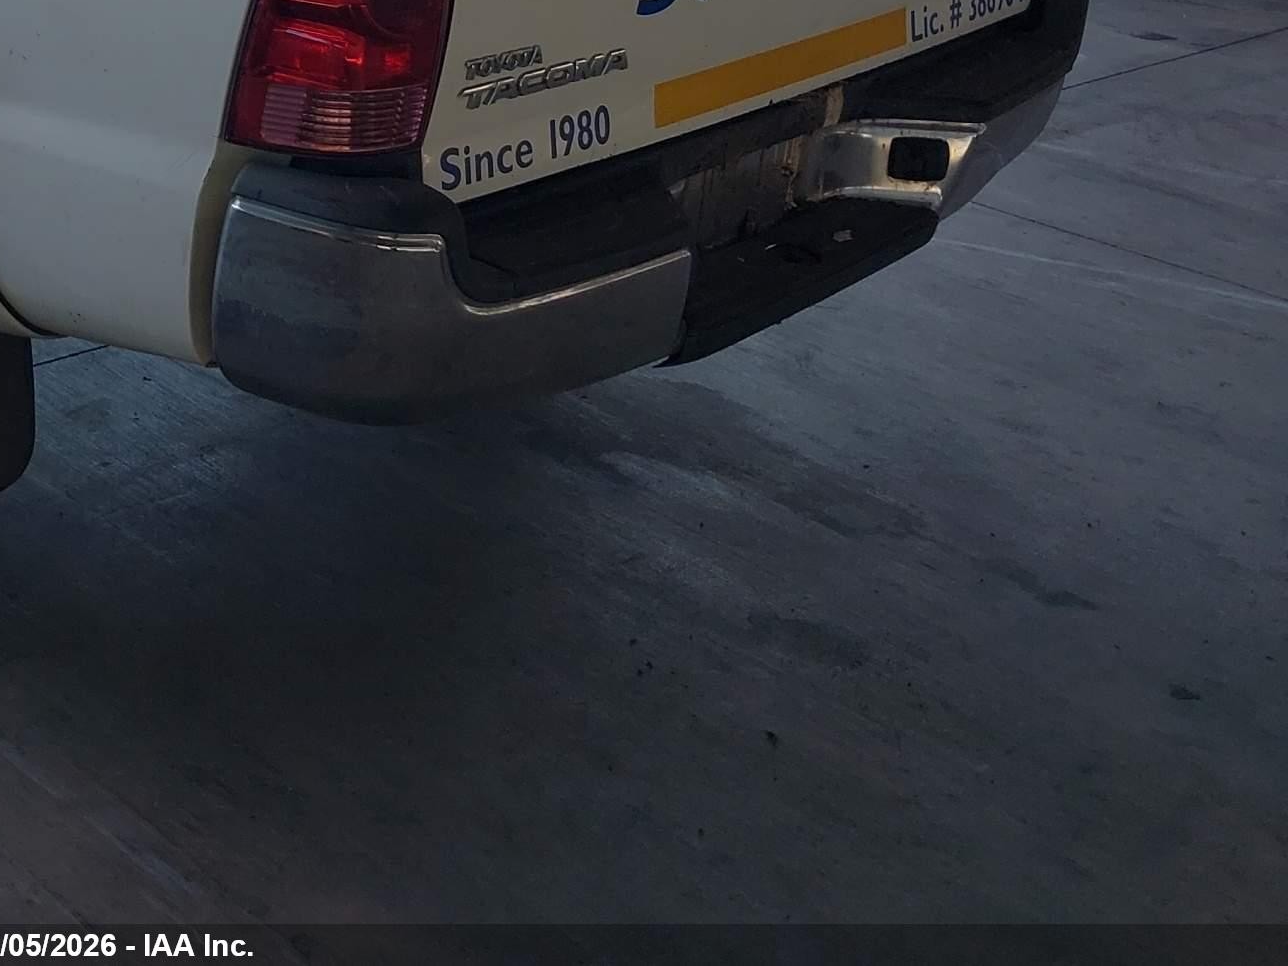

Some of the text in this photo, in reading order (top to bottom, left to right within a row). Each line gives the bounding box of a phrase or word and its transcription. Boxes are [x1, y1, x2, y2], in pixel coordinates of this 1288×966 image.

[910, 5, 944, 43] Lic.
[457, 48, 628, 110] TACOMA
[464, 45, 543, 80] TOYOTA
[440, 105, 610, 191] Since 1980
